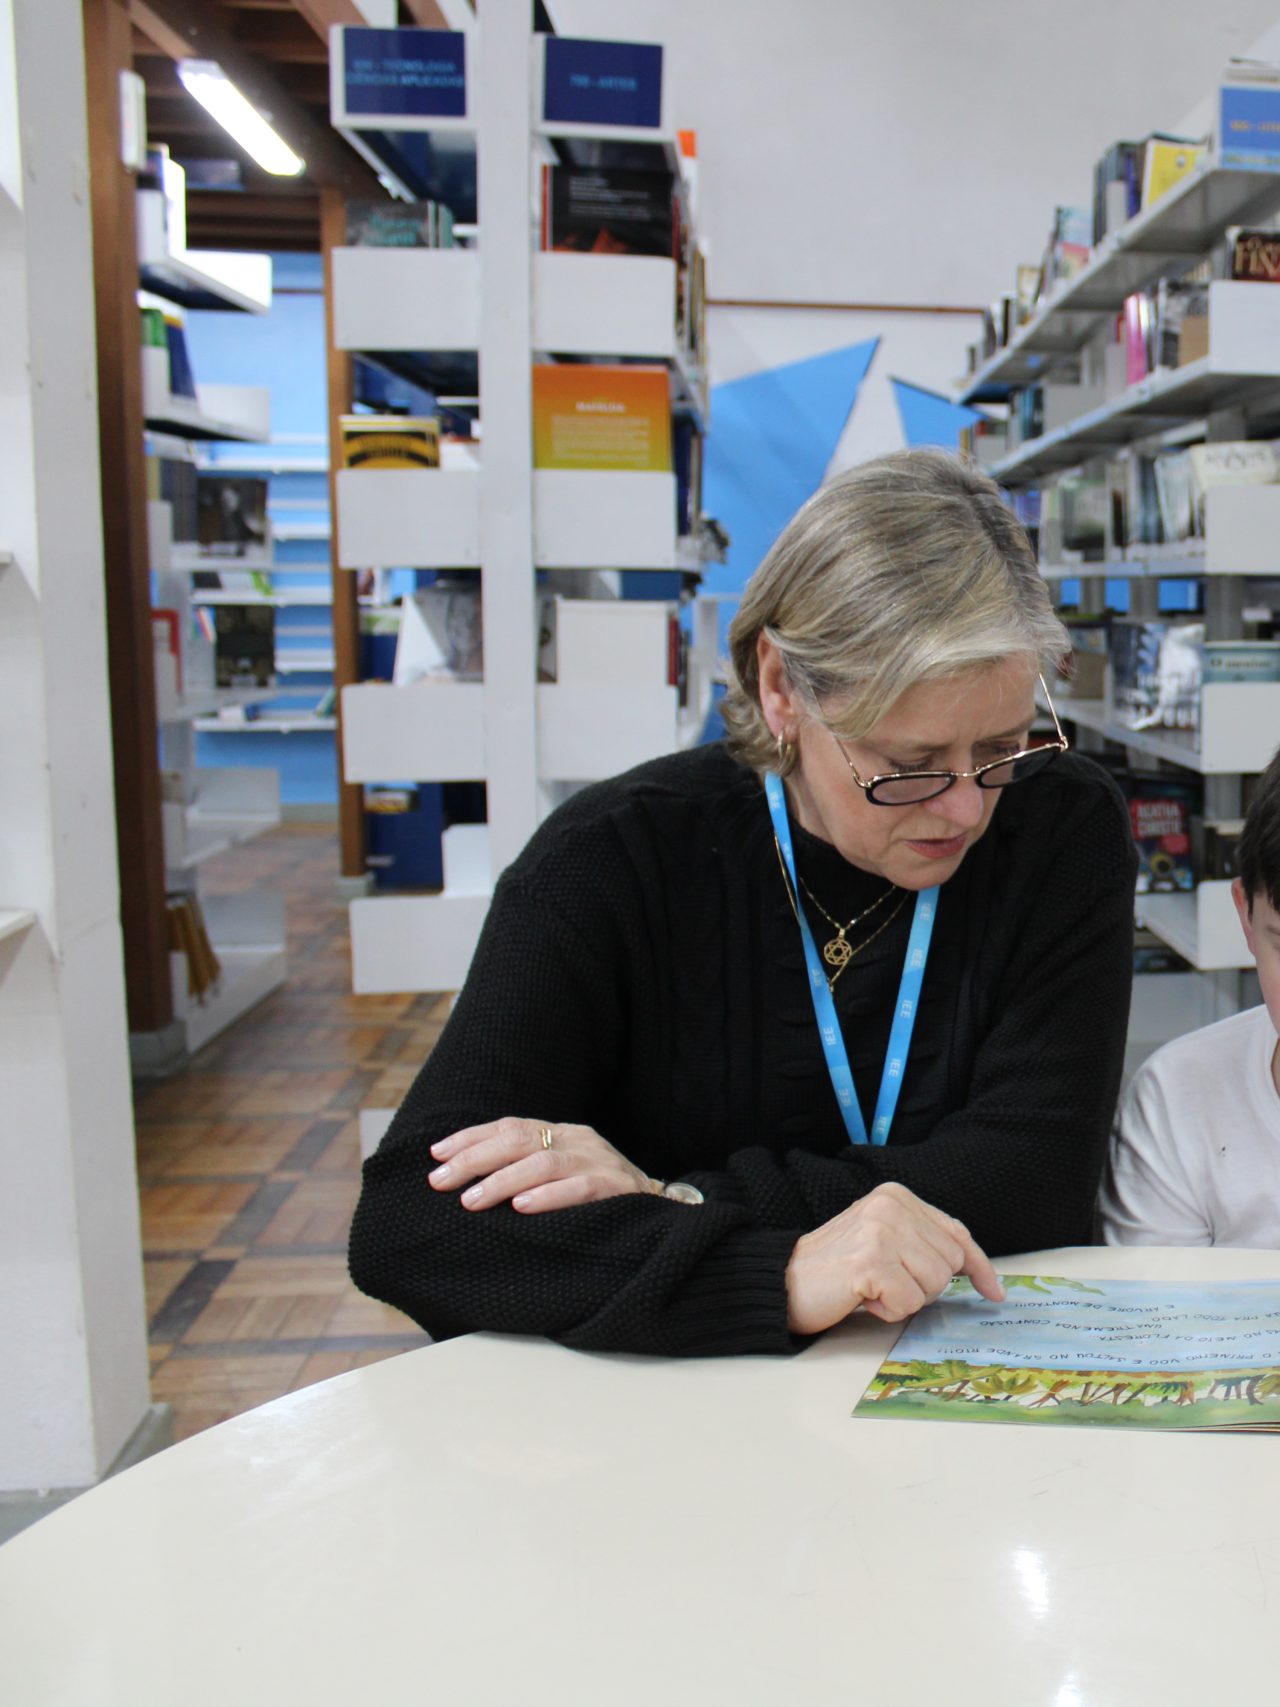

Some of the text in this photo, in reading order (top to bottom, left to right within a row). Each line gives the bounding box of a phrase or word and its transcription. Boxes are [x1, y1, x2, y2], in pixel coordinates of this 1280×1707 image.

[1137, 802, 1181, 817] AGATHA
[1138, 819, 1182, 836] CHRISTIE
[900, 999, 912, 1018] IEE
[823, 1026, 836, 1045] IEE
[889, 1058, 902, 1077] IEE
[1055, 1322, 1136, 1331] TREMENDA
[986, 1348, 1042, 1360] GRANDE
[1077, 1353, 1127, 1362] SALTOU
[1186, 1353, 1254, 1361] PRIMEIRO
